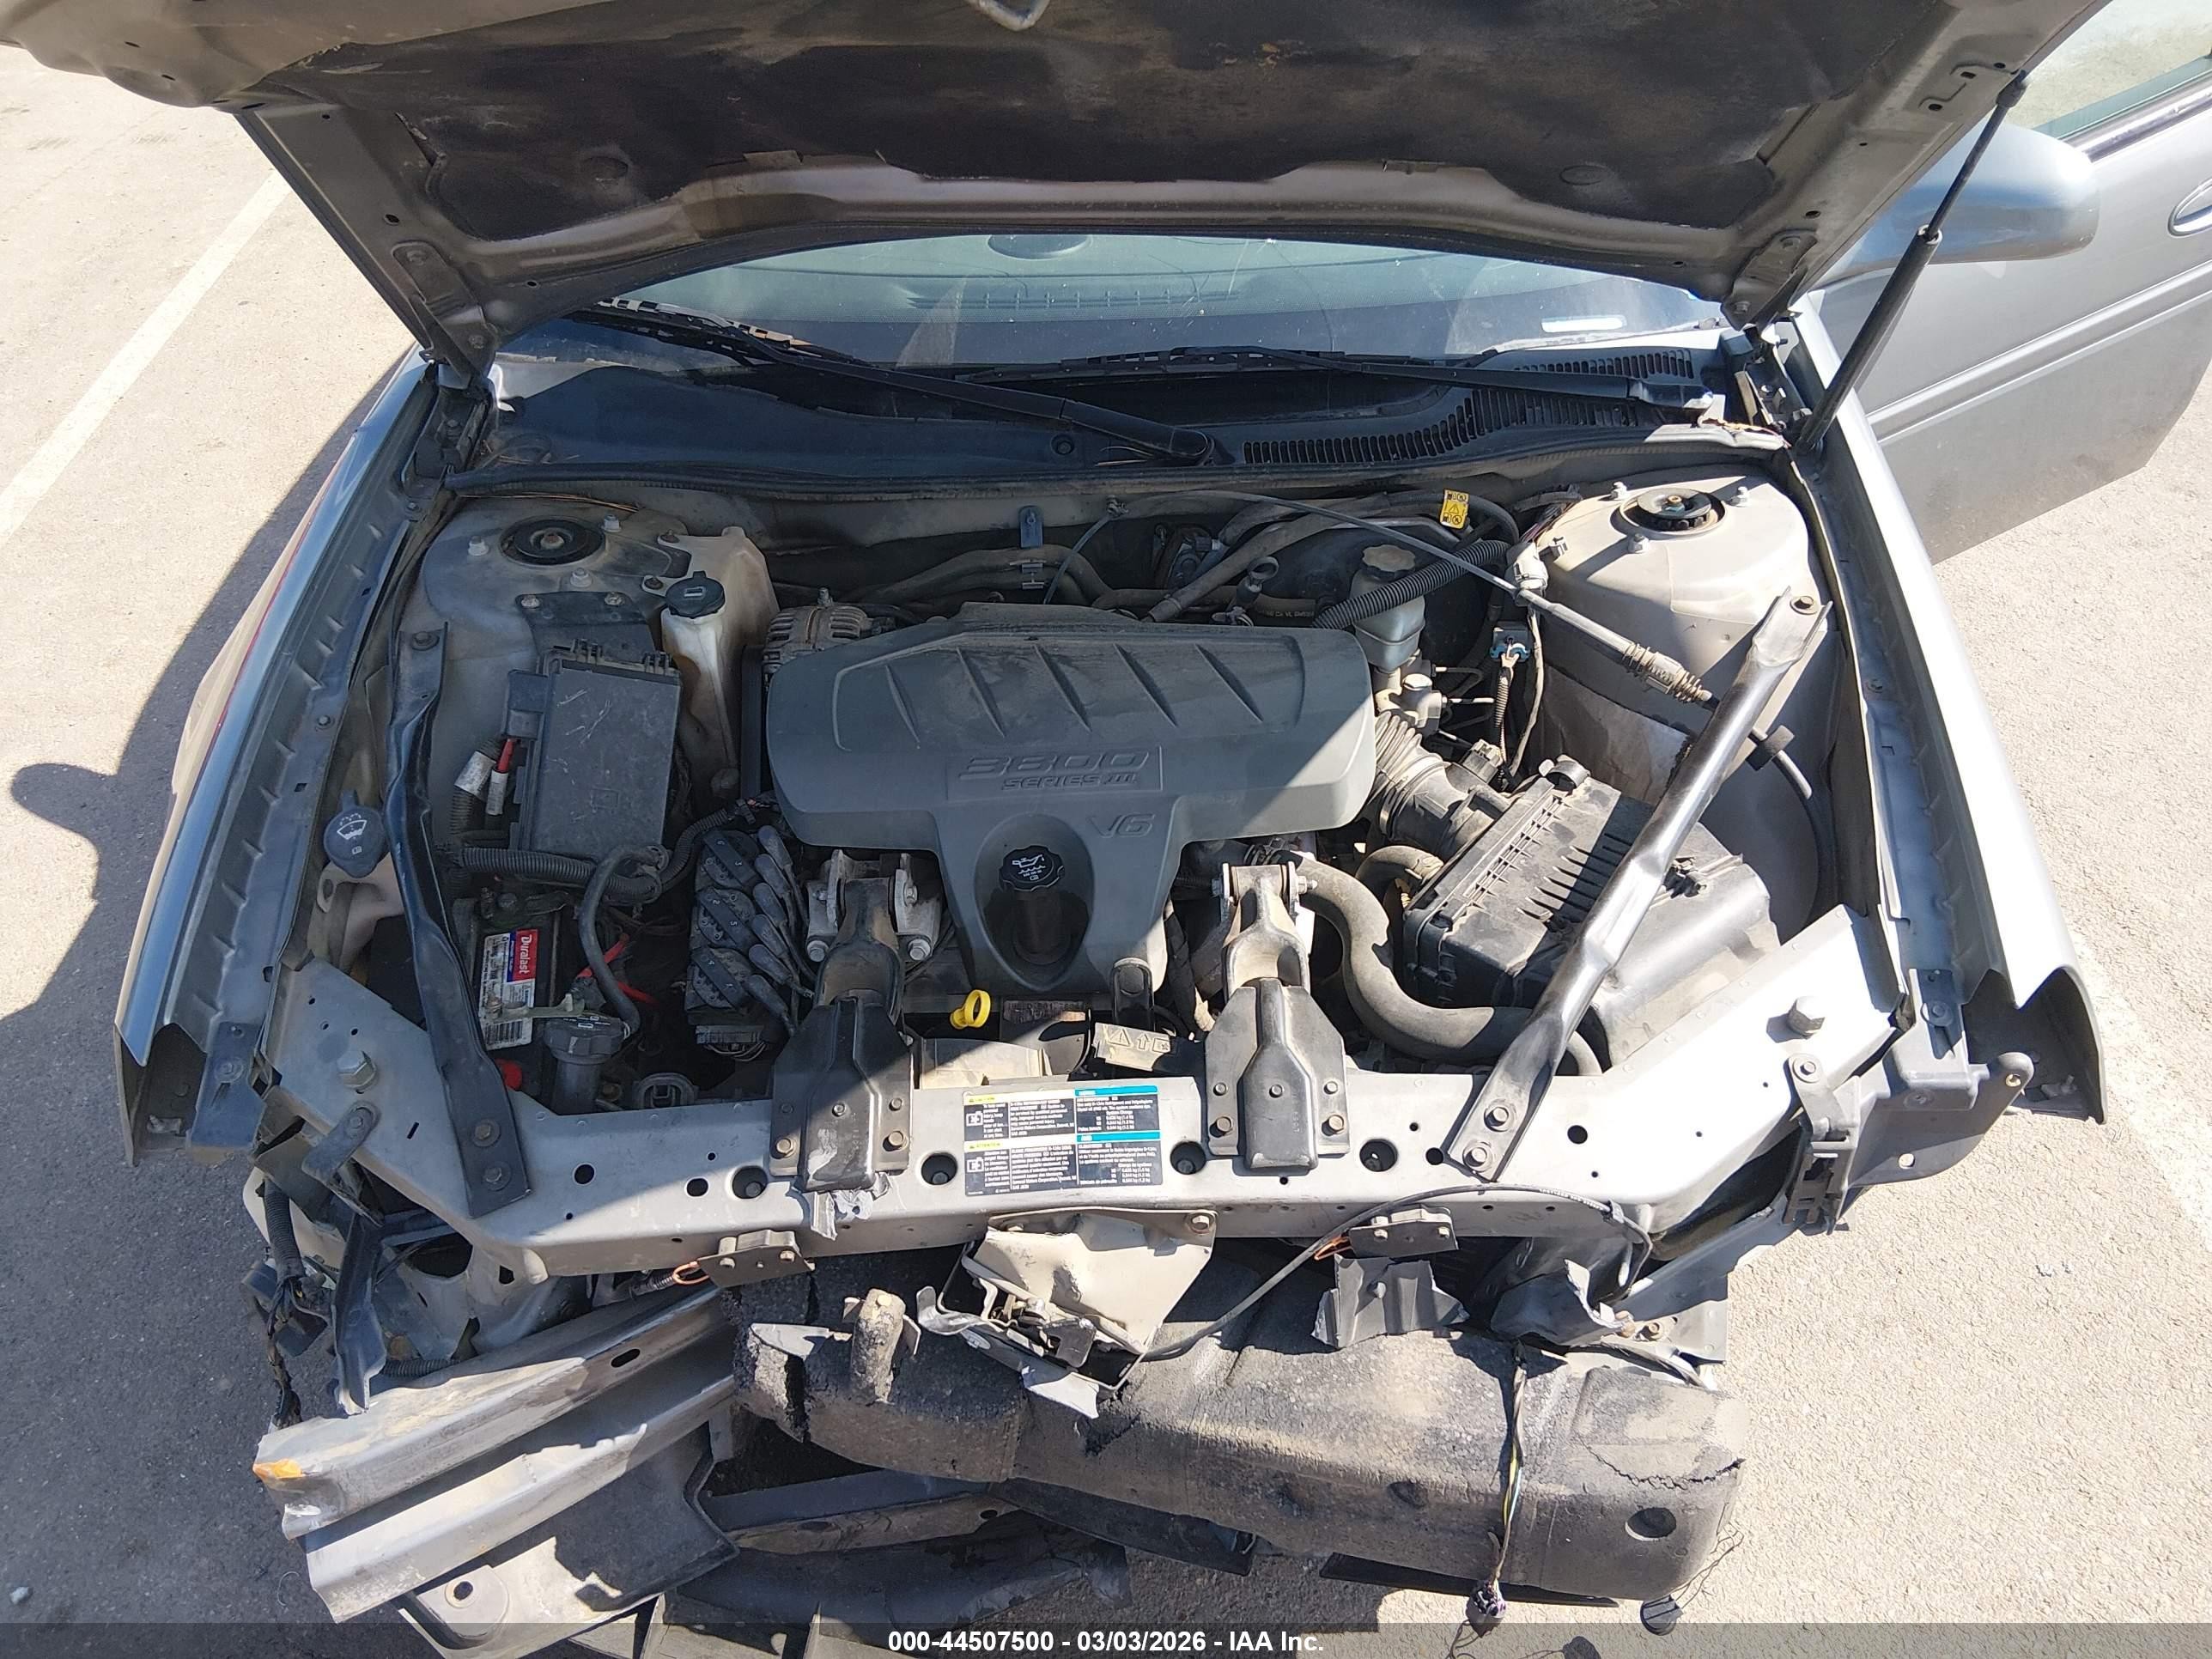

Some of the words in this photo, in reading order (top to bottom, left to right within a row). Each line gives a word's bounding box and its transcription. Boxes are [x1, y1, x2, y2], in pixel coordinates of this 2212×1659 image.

[957, 751, 1150, 780] 3800
[1001, 775, 1100, 791] SERIES
[1087, 812, 1156, 839] V6
[518, 933, 533, 975] Duralast
